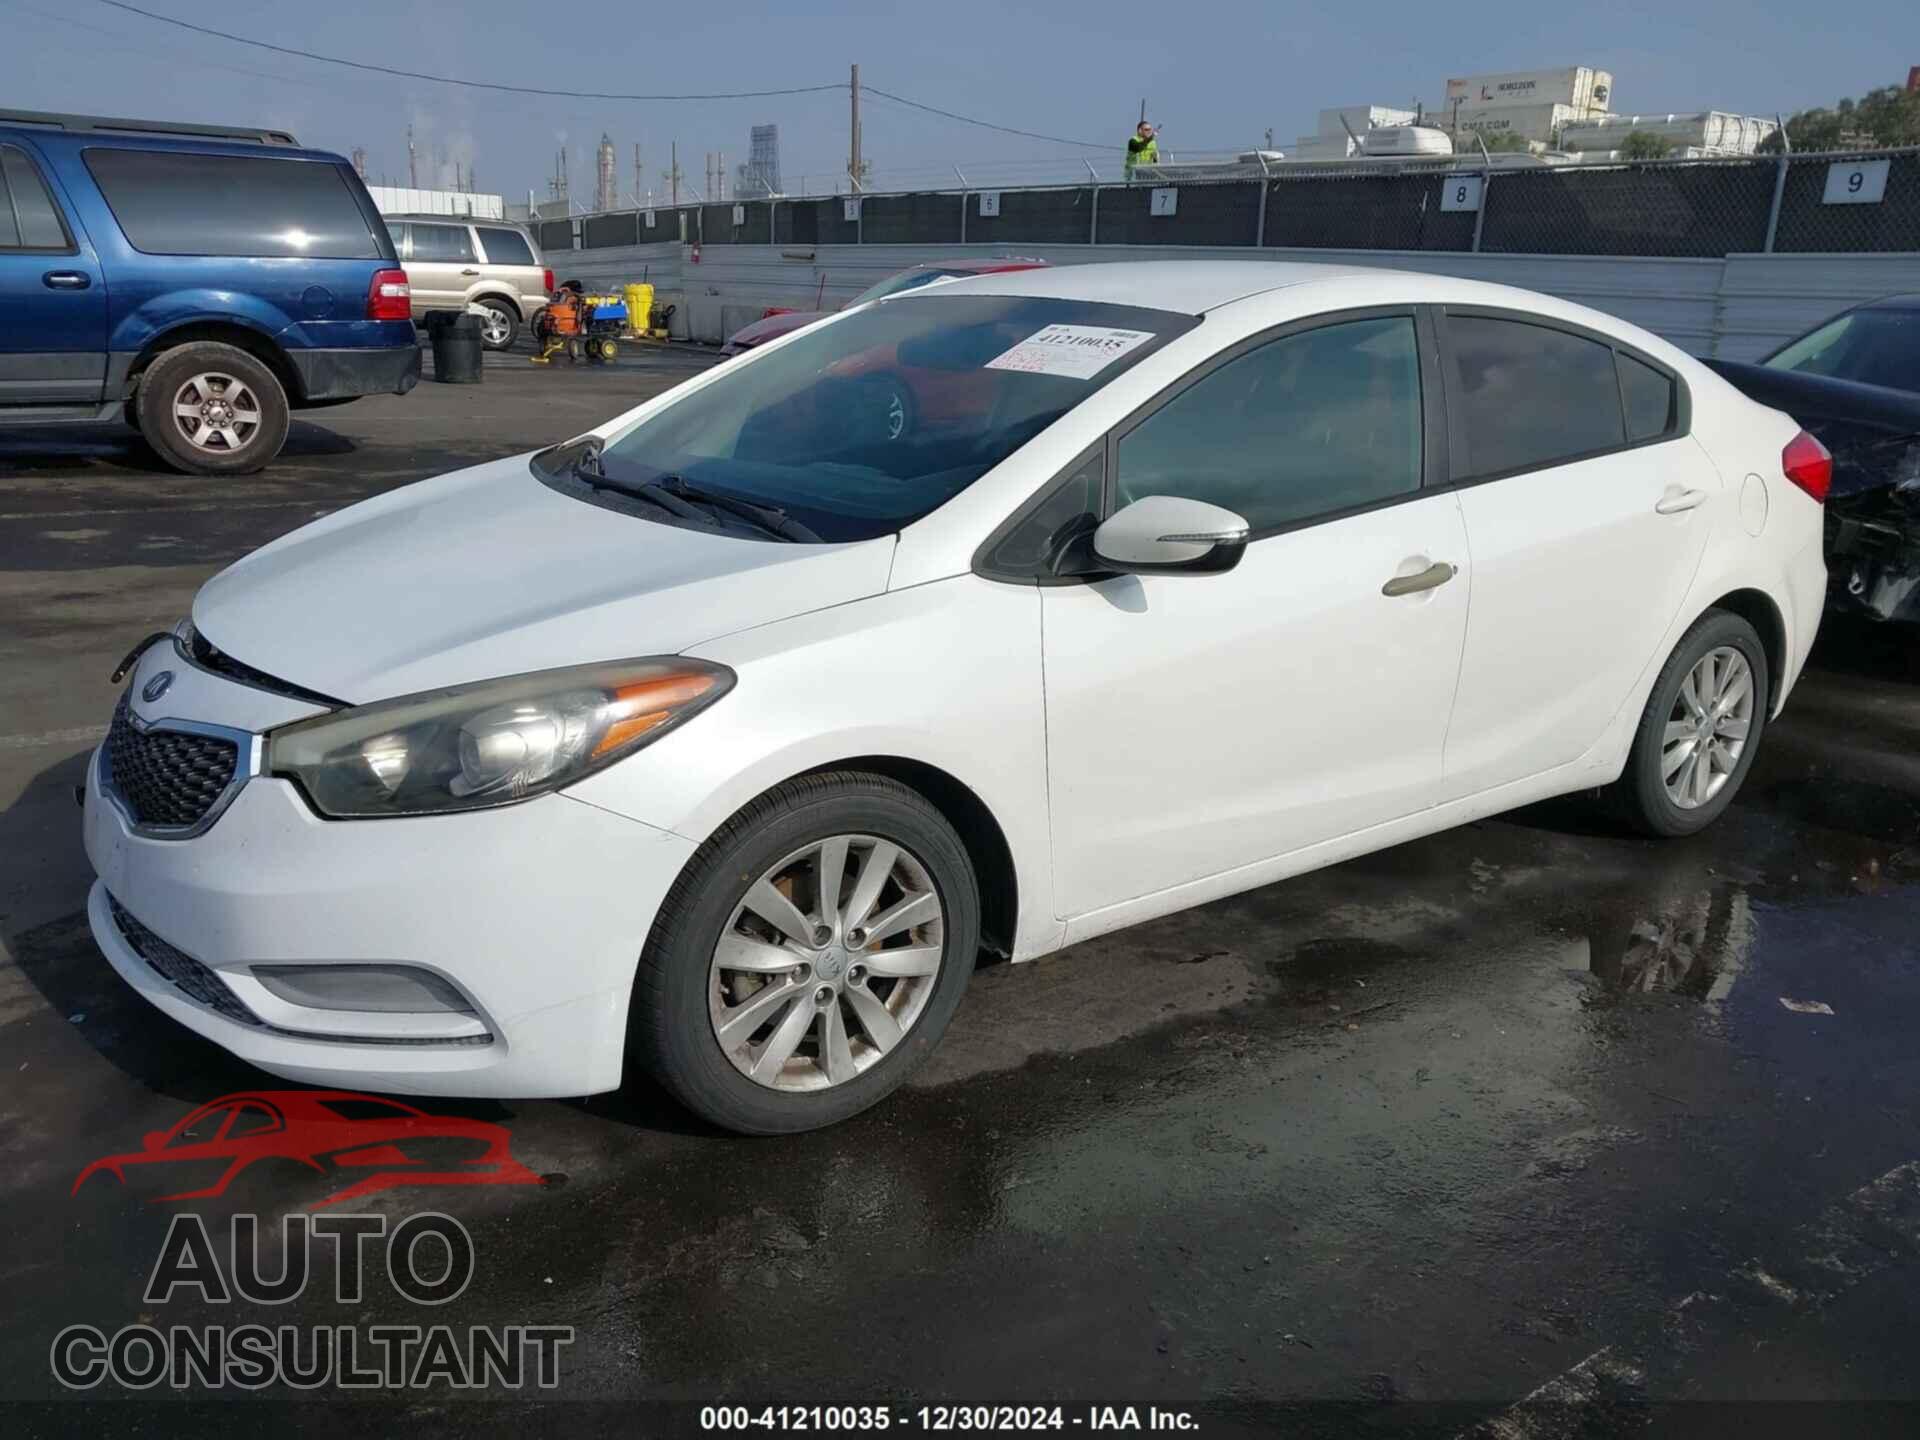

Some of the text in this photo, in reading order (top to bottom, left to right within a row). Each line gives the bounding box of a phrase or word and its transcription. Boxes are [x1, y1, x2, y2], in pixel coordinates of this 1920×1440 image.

[1848, 172, 1864, 193] 9
[1160, 195, 1168, 209] 7
[1457, 186, 1466, 203] 8
